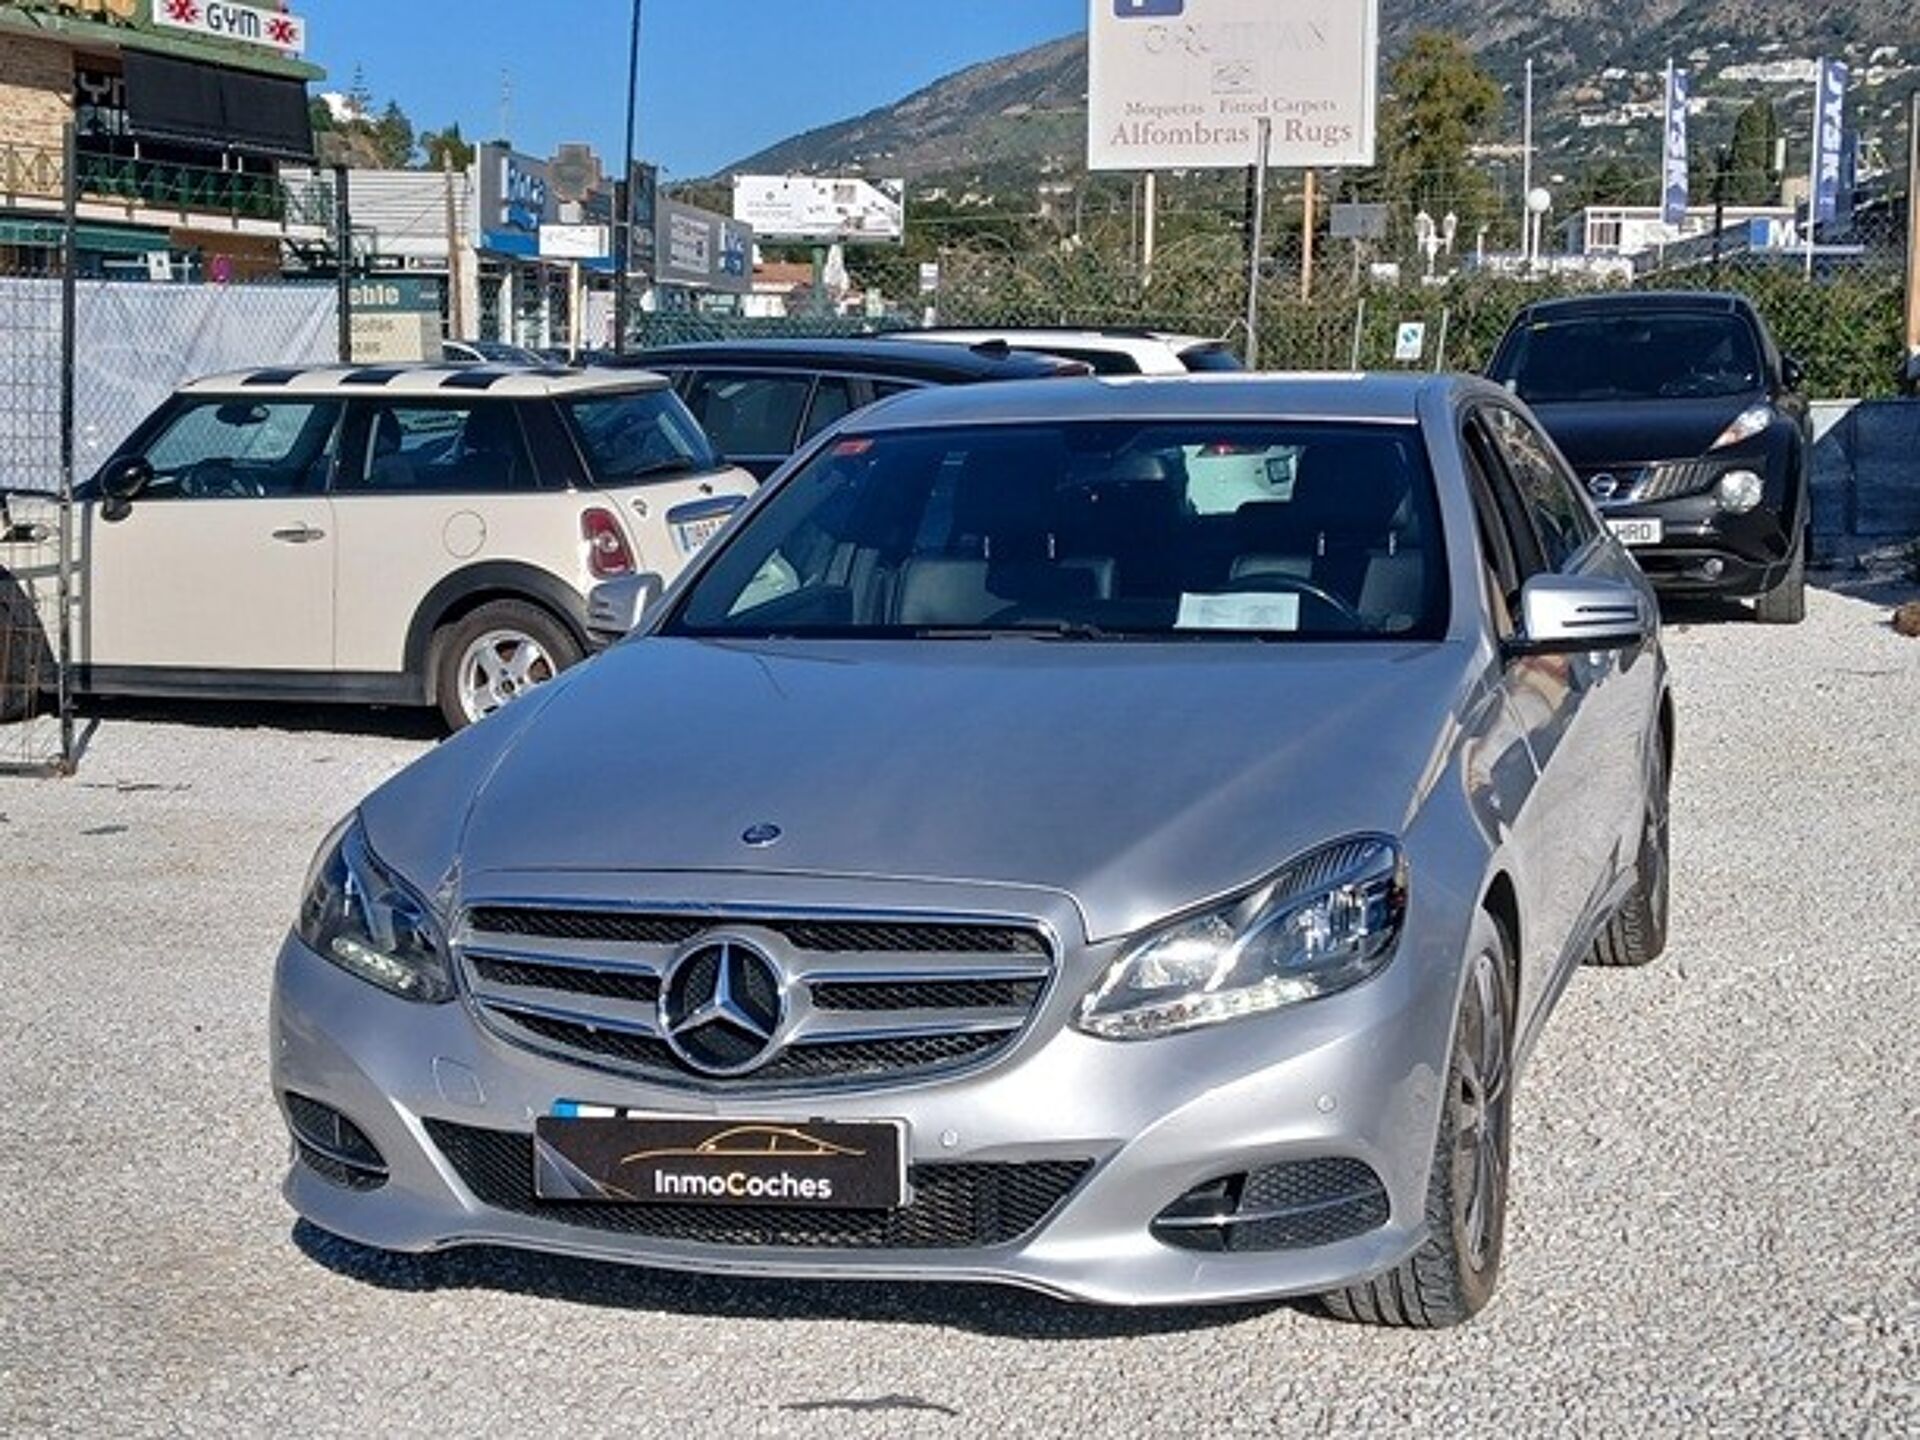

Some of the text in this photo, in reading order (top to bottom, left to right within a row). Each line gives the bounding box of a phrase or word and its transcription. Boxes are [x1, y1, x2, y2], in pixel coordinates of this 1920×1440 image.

[206, 2, 262, 38] GYM
[1125, 97, 1337, 119] Moquetas Fitted Carpets
[1821, 61, 1848, 184] JYSK
[1110, 119, 1352, 148] Alfombras Rugs
[654, 1168, 833, 1199] InmoCoches
